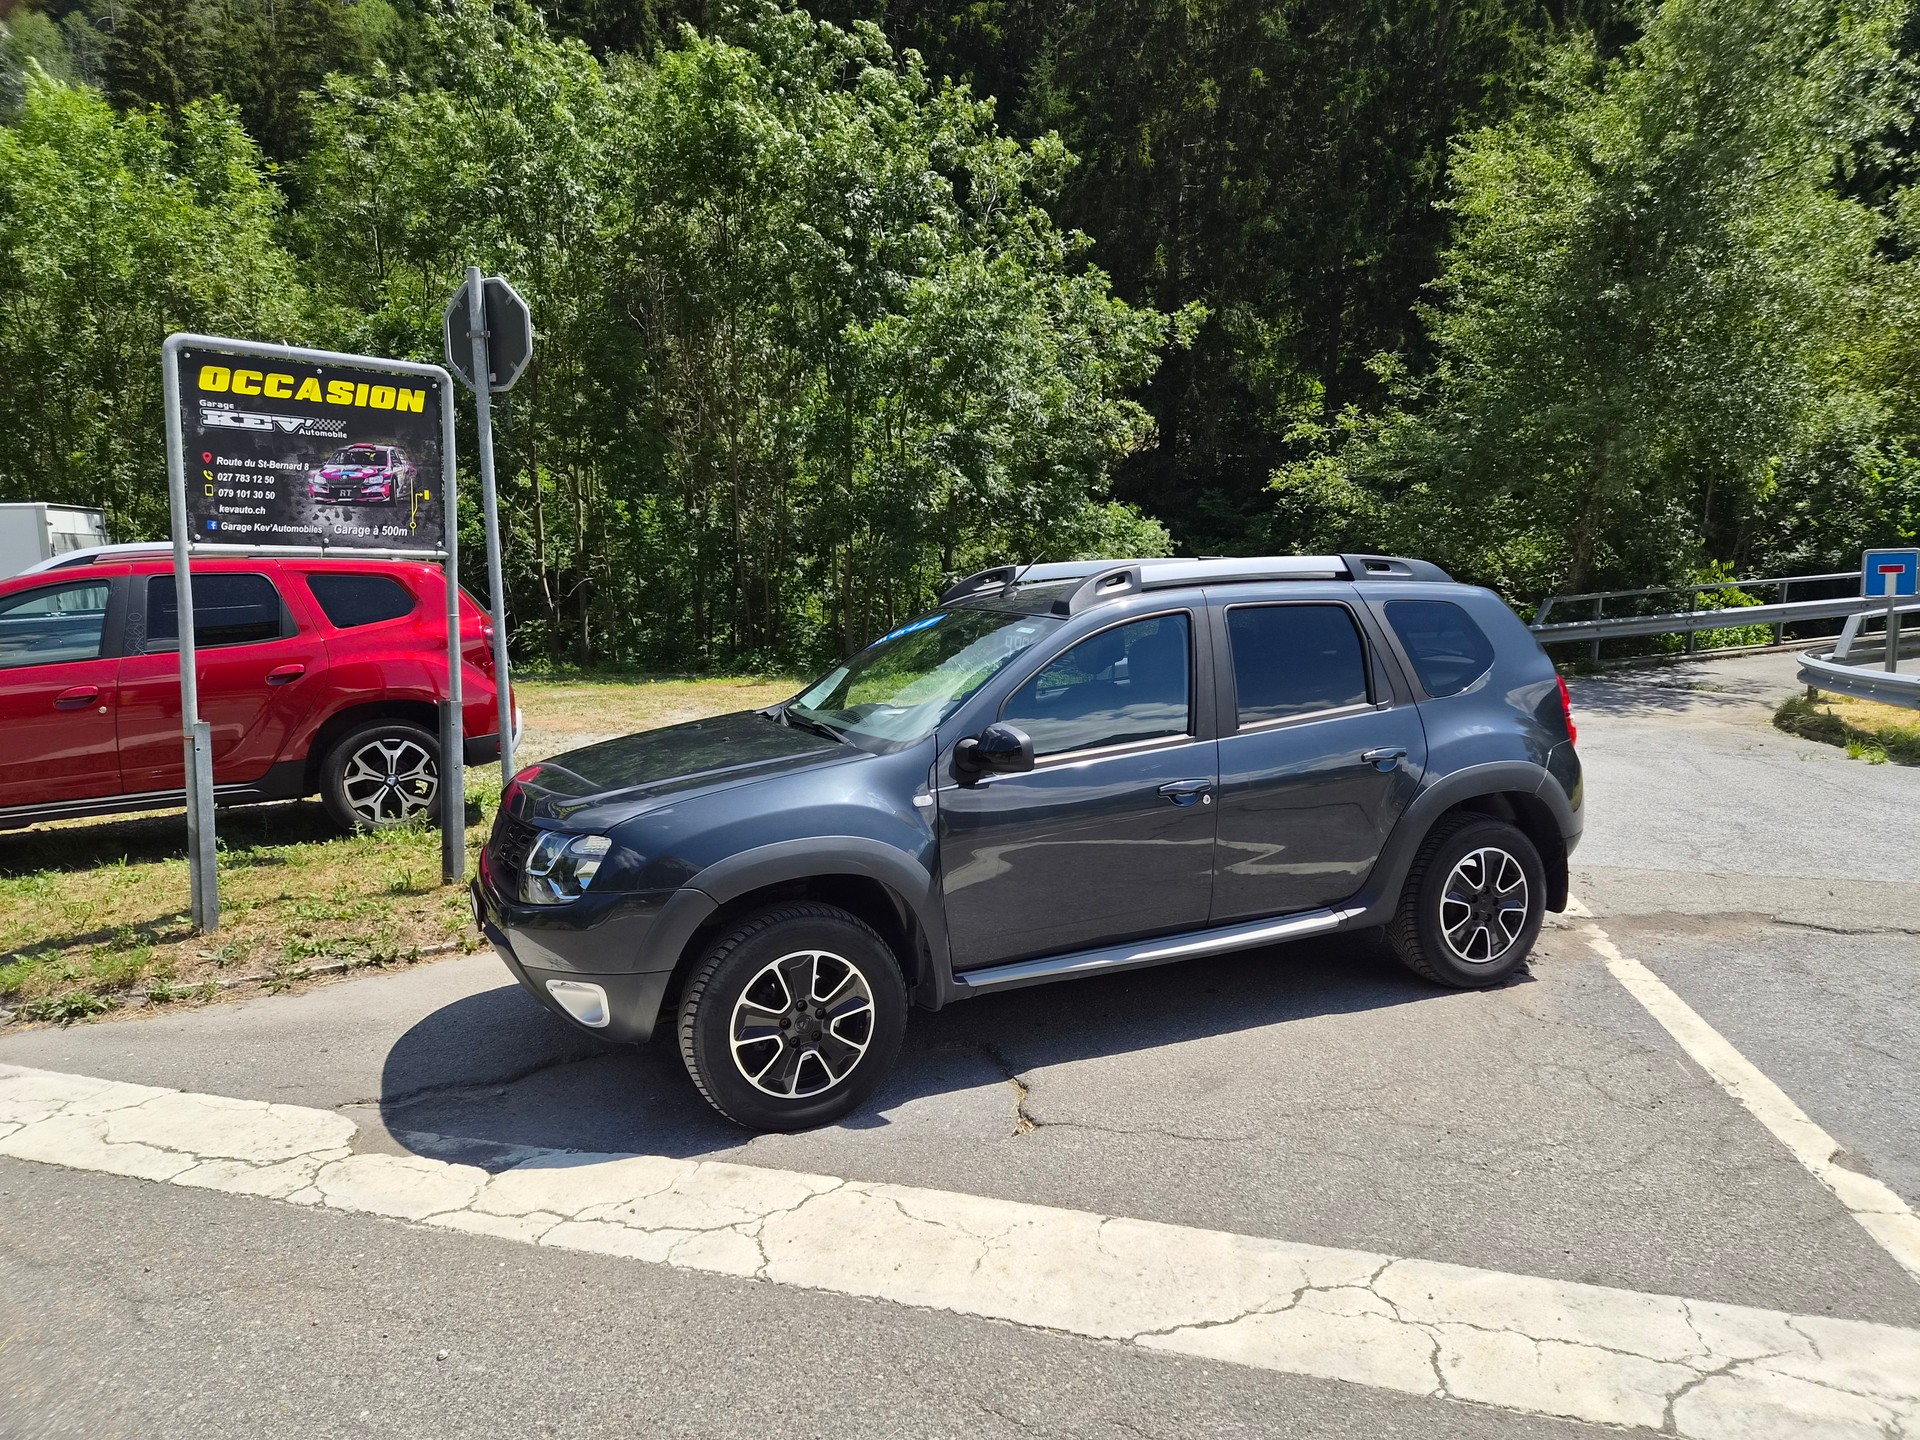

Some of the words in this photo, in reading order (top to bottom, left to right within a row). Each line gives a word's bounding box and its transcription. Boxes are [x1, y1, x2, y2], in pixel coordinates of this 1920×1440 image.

[198, 365, 426, 413] OCCASION
[199, 399, 235, 410] Garage
[298, 428, 348, 439] Automobile
[216, 456, 243, 467] Route
[245, 458, 256, 468] du
[257, 459, 302, 471] St-Bernard
[304, 463, 310, 471] 8
[217, 472, 233, 482] 027
[235, 473, 250, 483] 783
[252, 475, 263, 484] 12
[264, 475, 275, 484] 50
[218, 488, 234, 498] 079
[236, 489, 251, 498] 101
[252, 490, 264, 499] 30
[265, 490, 276, 500] 50
[219, 504, 266, 515] kevauto.ch
[220, 521, 252, 533] Garage
[253, 522, 323, 534] Kev'Automobiles
[333, 523, 371, 537] Garage
[372, 524, 379, 535] à
[381, 525, 408, 537] 500m
